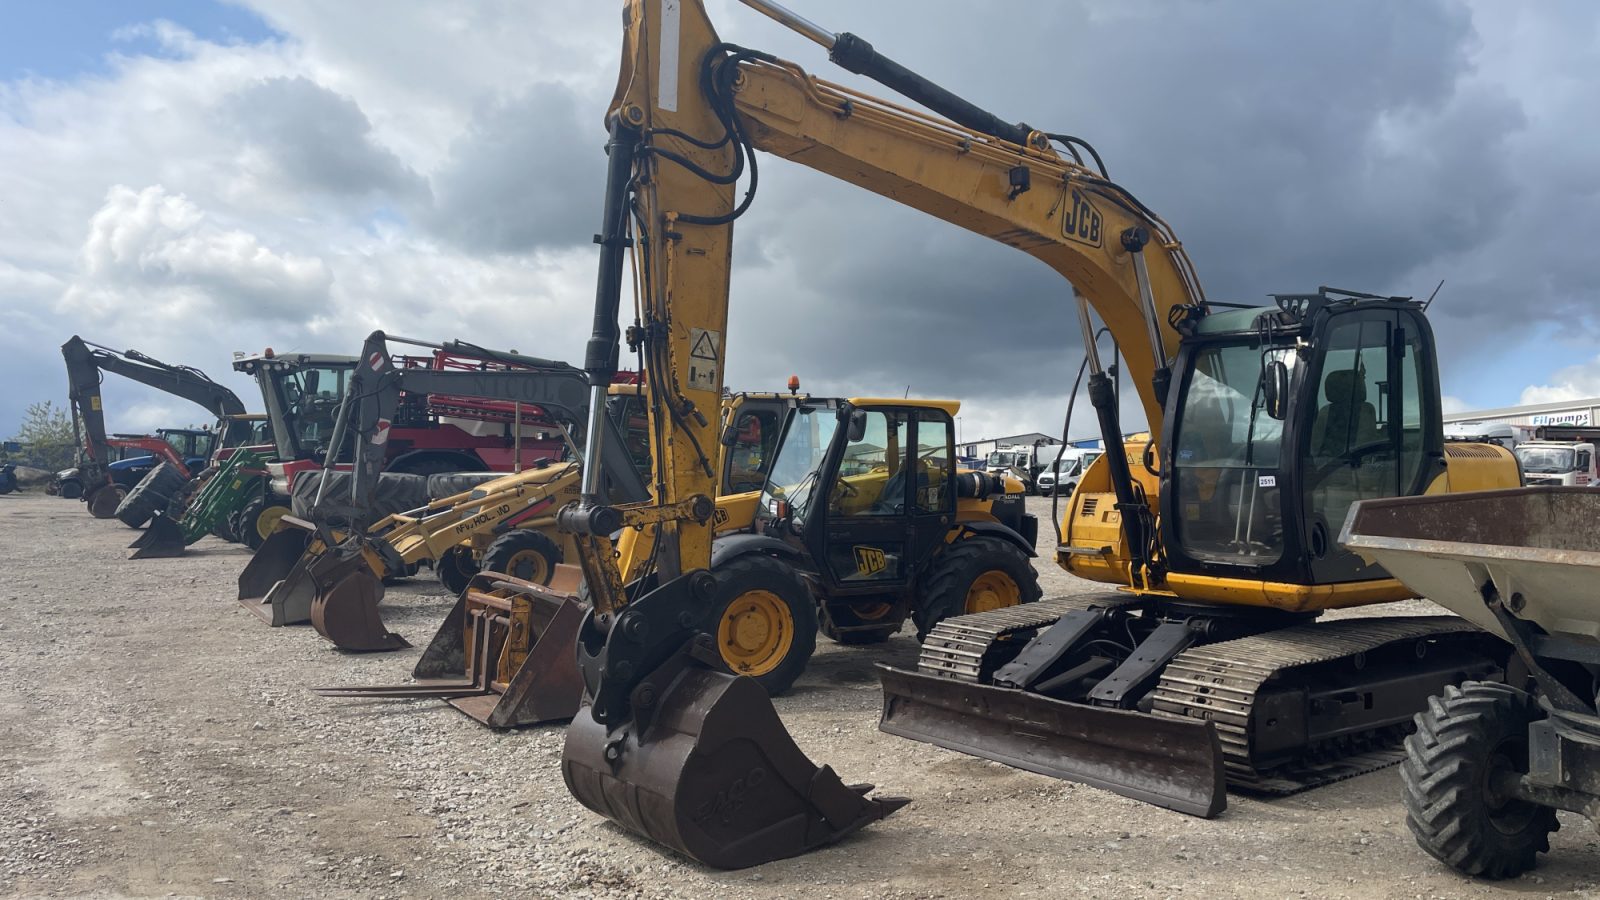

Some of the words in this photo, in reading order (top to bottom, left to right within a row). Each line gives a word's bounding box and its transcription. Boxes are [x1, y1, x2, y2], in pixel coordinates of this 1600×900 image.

[1065, 188, 1100, 242] JCB
[474, 377, 553, 401] NICOL
[1533, 413, 1588, 426] Filpumps
[473, 504, 510, 527] HOLND
[714, 510, 727, 524] CB
[857, 549, 885, 576] JCB
